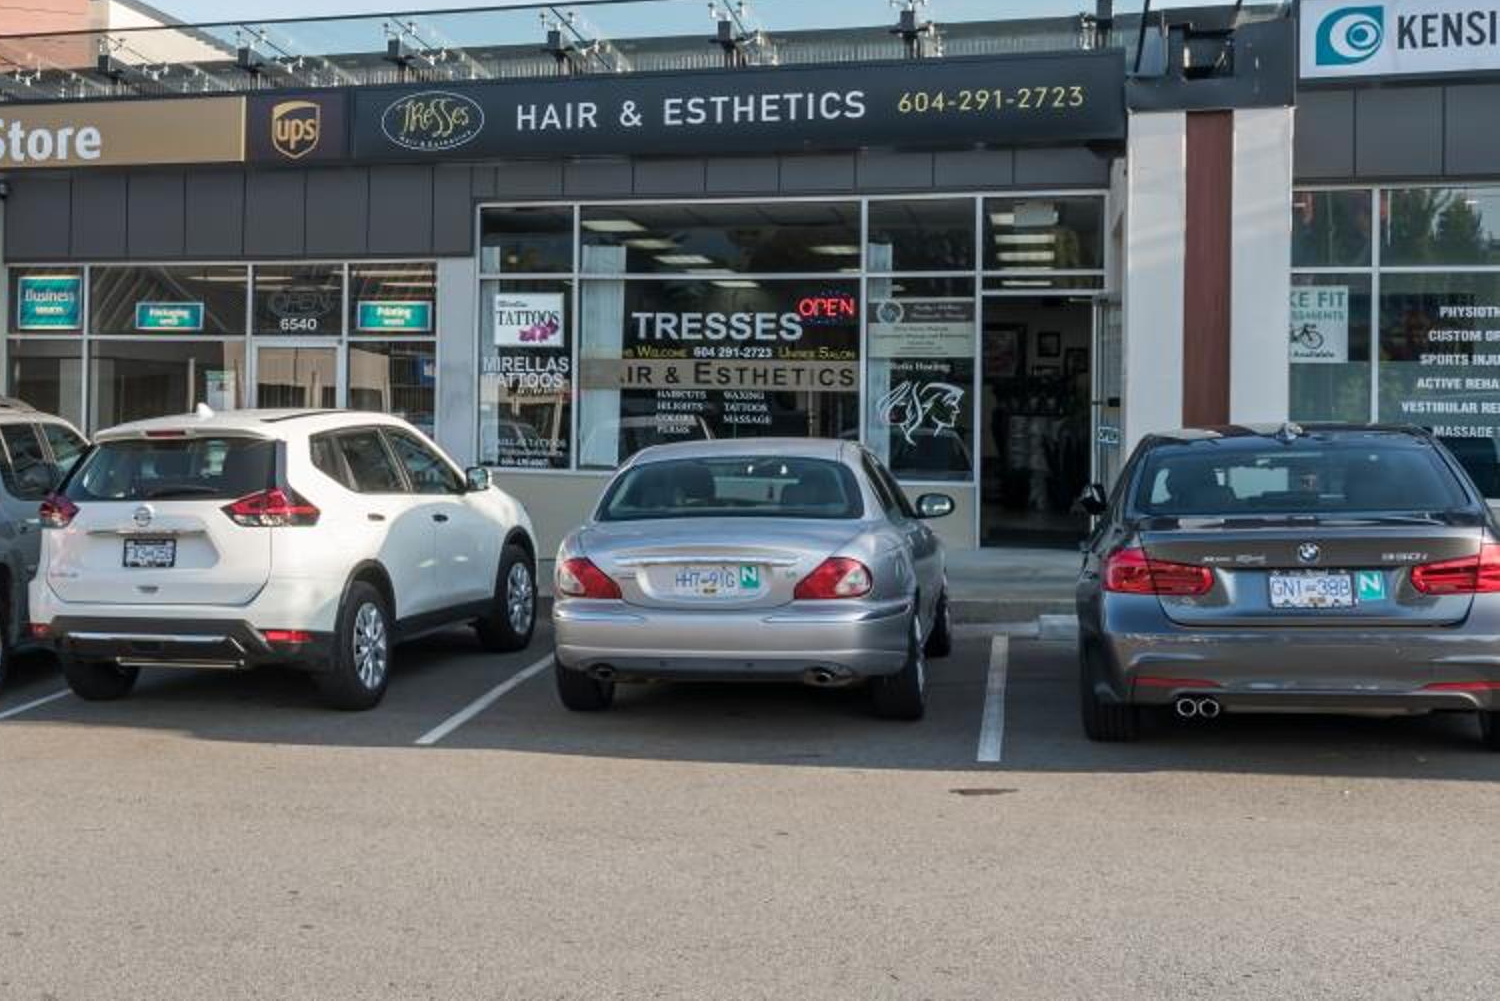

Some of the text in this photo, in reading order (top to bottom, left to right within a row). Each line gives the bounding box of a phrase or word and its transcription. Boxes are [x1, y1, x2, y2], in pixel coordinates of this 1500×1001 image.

[1397, 10, 1497, 50] KENSI
[516, 86, 1084, 130] HAIR & ESTHETICS 604-291-2723
[276, 118, 316, 150] ups
[799, 298, 855, 317] OPEN
[1317, 291, 1347, 308] FIT
[279, 317, 318, 331] 6540
[495, 310, 560, 327] TATTOOS
[630, 311, 804, 341] TRESSES
[1427, 330, 1483, 342] CUSTOM
[693, 346, 716, 358] 604
[719, 346, 773, 358] 291-2723
[1419, 354, 1469, 366] SPORTS
[483, 355, 570, 373] MIRELLAS
[485, 373, 565, 388] TATTOOS
[664, 366, 680, 385] &
[693, 361, 855, 387] ESTHETICS
[1416, 378, 1462, 390] ACTIVE
[1401, 401, 1478, 414] VESTIBULAR
[1432, 425, 1493, 438] MASSAGE
[1360, 573, 1381, 592] N
